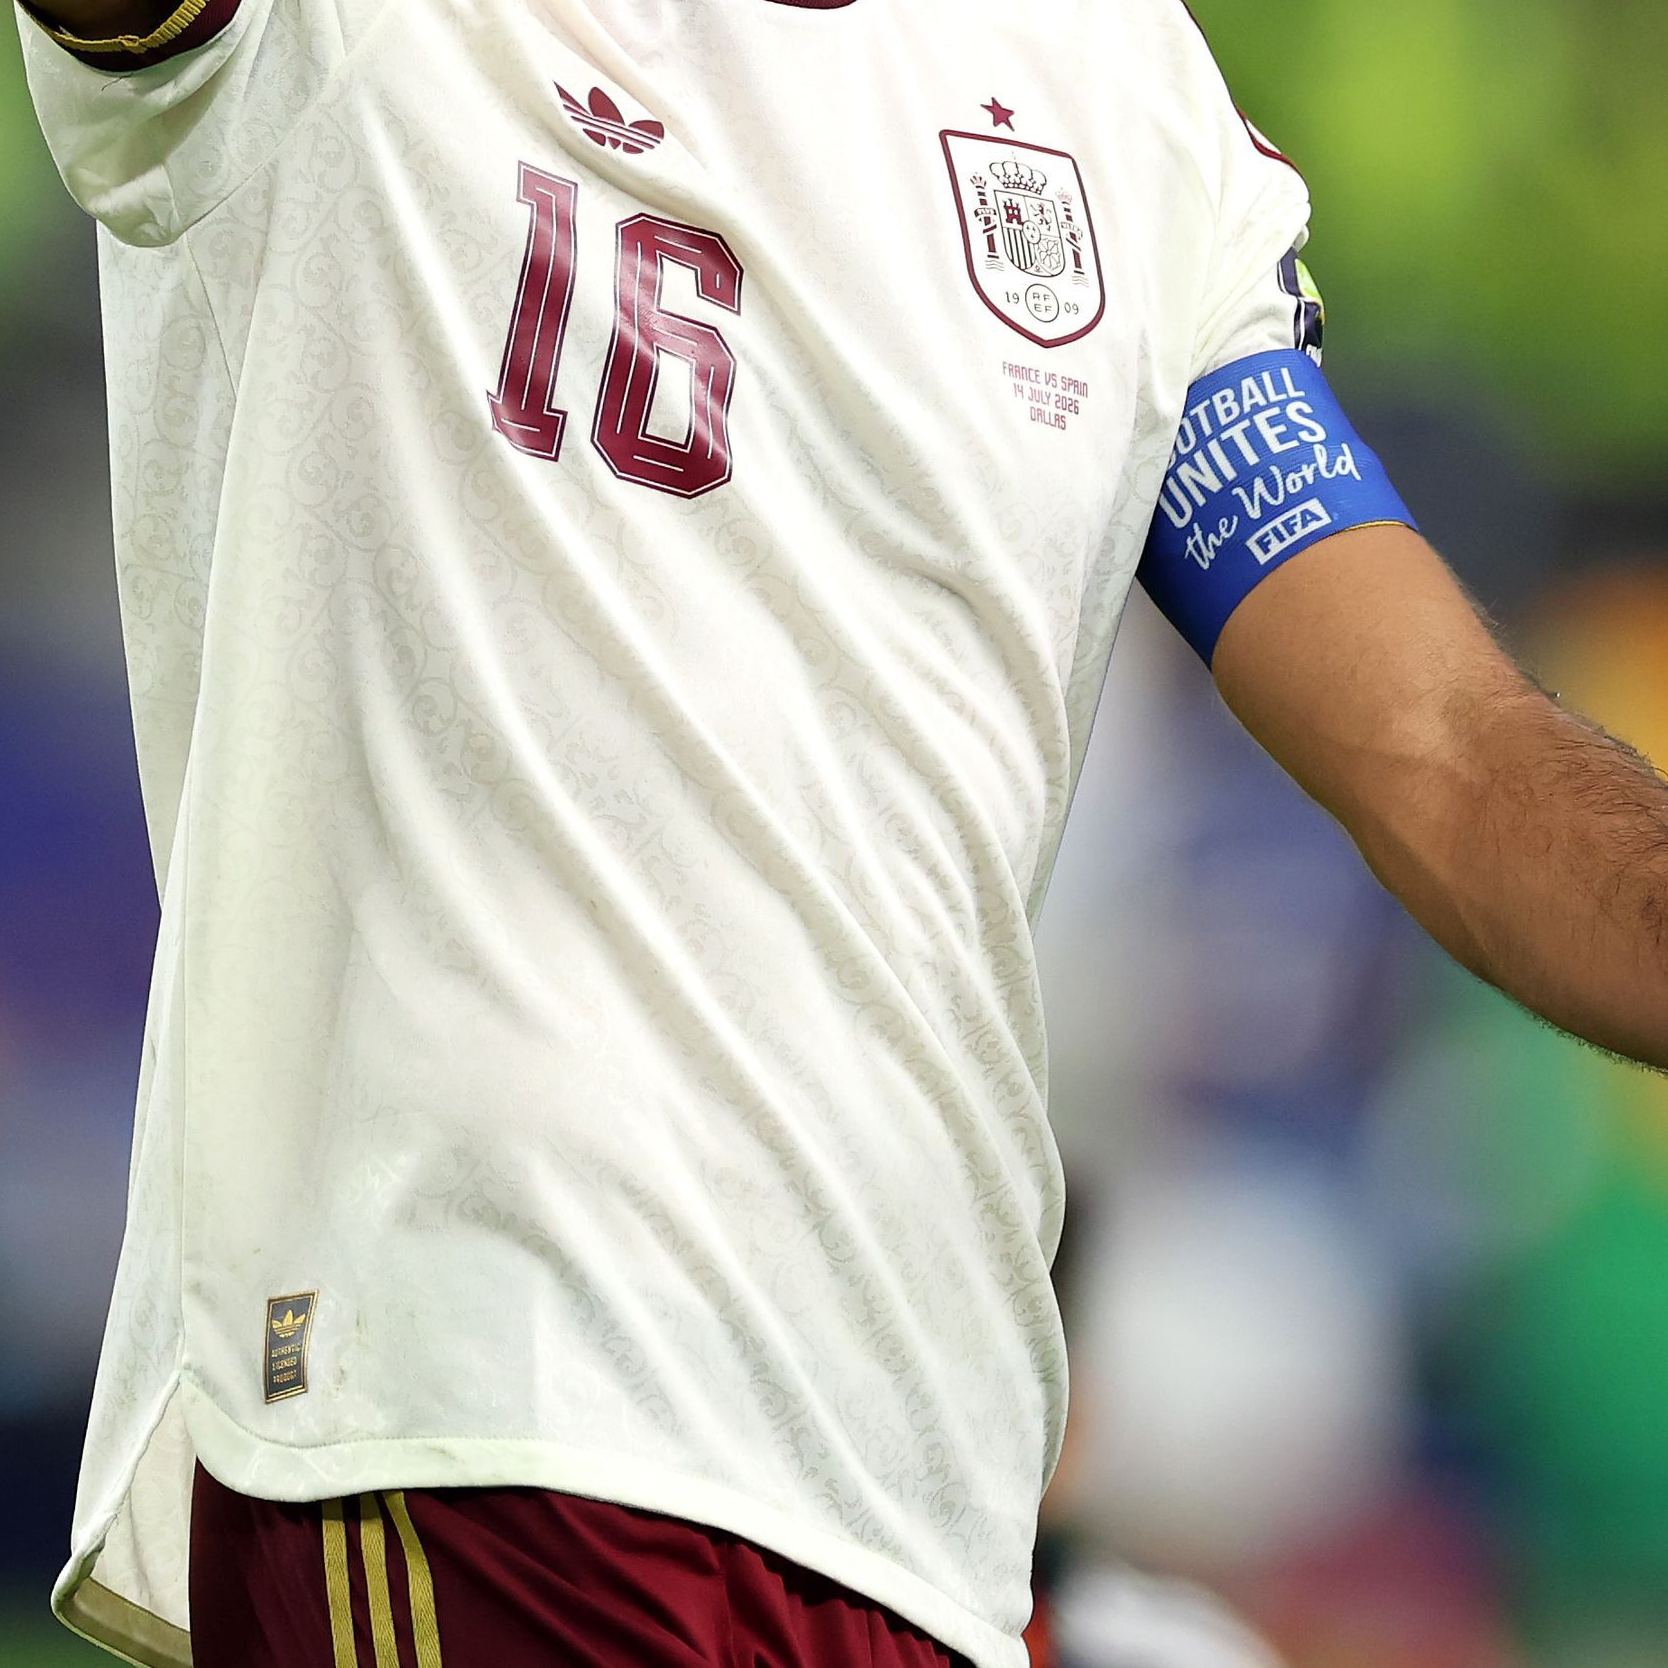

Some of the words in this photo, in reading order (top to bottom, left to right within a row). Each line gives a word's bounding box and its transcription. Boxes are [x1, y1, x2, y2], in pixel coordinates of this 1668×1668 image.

[486, 160, 744, 499] 16
[1006, 291, 1020, 304] 19
[1064, 302, 1079, 315] 09
[1002, 361, 1041, 384] FRANCE
[1044, 372, 1058, 388] VS
[1061, 376, 1088, 398] SPAIN
[1014, 383, 1024, 399] 14
[1028, 387, 1051, 405] JULY
[1055, 394, 1079, 415] 2026
[1030, 406, 1066, 430] DALLAS
[1168, 367, 1305, 469] OTBALL
[1158, 401, 1327, 529] UNITES
[1185, 515, 1238, 570] the
[1232, 443, 1362, 519] World
[1252, 505, 1326, 558] FIFA
